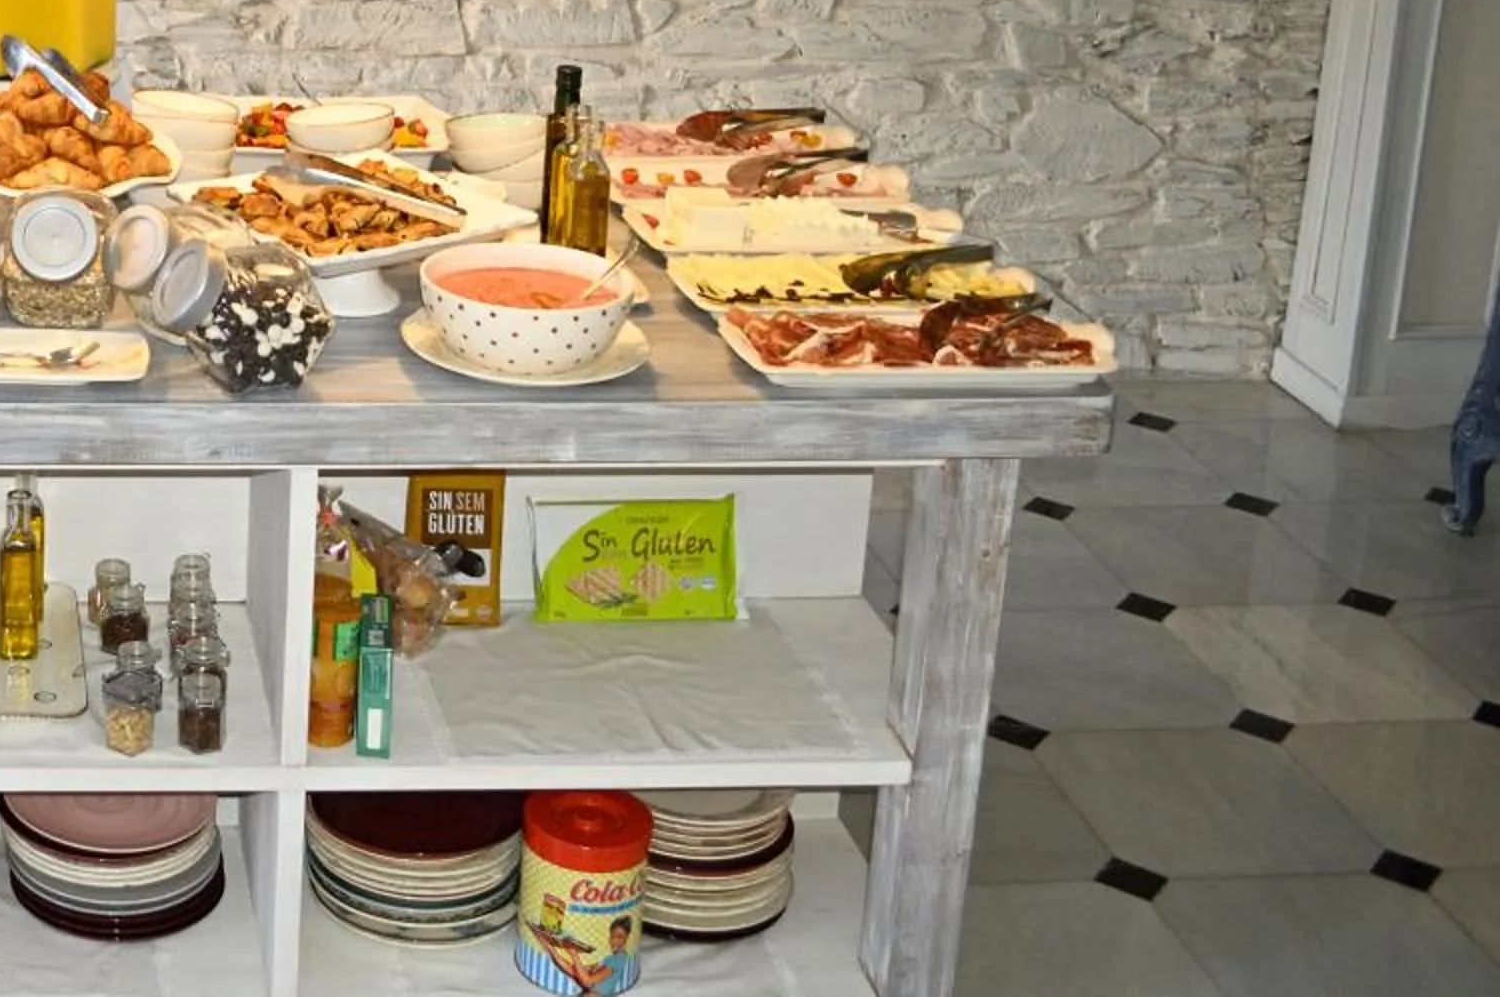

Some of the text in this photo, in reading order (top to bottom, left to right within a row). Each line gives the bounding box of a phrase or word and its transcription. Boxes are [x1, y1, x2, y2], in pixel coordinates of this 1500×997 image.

[429, 491, 485, 511] SIN SEM
[428, 513, 485, 535] GLUTEN
[582, 527, 717, 562] Sin Gluten
